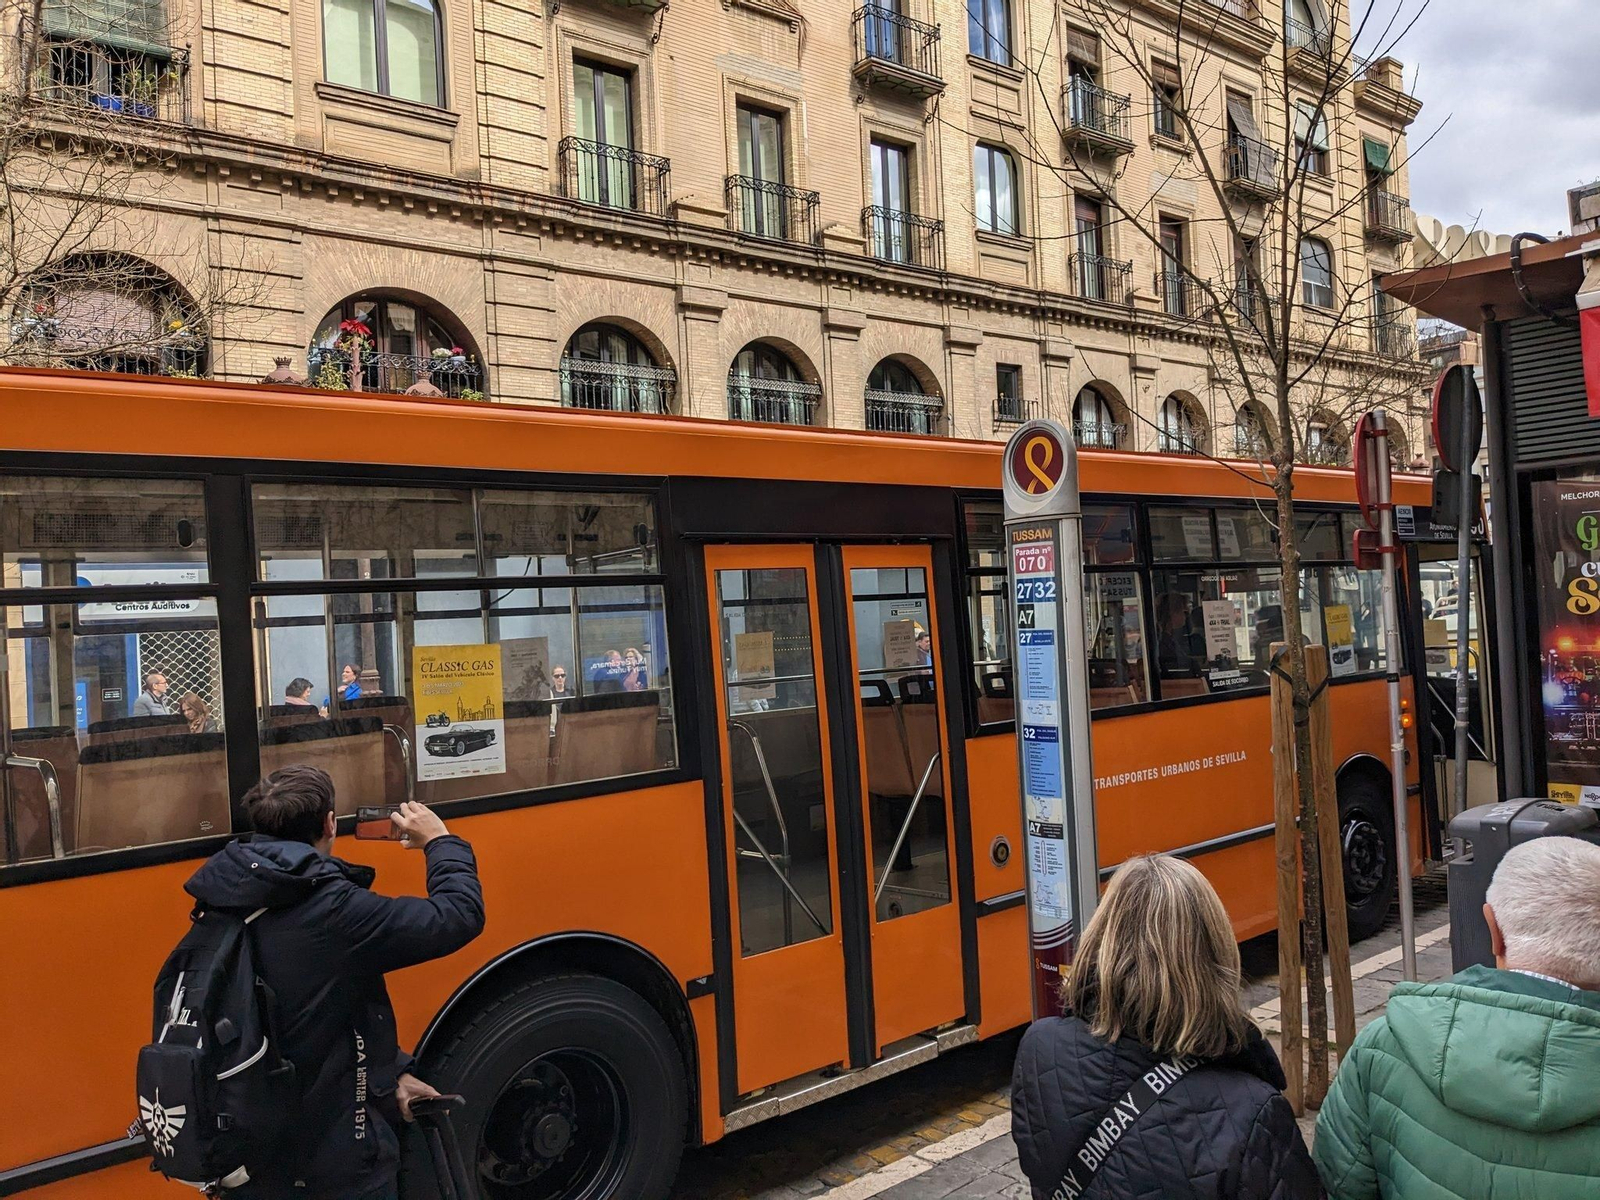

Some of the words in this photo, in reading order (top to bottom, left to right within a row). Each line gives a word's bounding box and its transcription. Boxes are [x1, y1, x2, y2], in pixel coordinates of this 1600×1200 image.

[1561, 490, 1600, 500] MELCHOR
[1012, 528, 1052, 542] TUSSAM
[1016, 547, 1039, 556] Parada
[1019, 556, 1046, 571] 070
[1017, 582, 1032, 599] 27
[1035, 581, 1056, 598] 32
[1566, 578, 1600, 615] S
[115, 602, 149, 611] Centros
[152, 601, 190, 610] Auditivos
[1018, 610, 1034, 624] A7
[1020, 633, 1032, 643] 27
[421, 661, 469, 672] CLASSIC
[472, 660, 494, 671] GAS
[1024, 728, 1035, 739] 32
[1094, 768, 1158, 789] TRANSPORTES
[1161, 760, 1200, 777] URBANOS
[1203, 757, 1213, 768] DE
[1216, 751, 1246, 766] SEVILLA
[1030, 822, 1041, 833] A7
[1040, 962, 1058, 972] TUSSAM
[355, 1107, 366, 1140] 1975
[1078, 1092, 1140, 1172] BIMBAY
